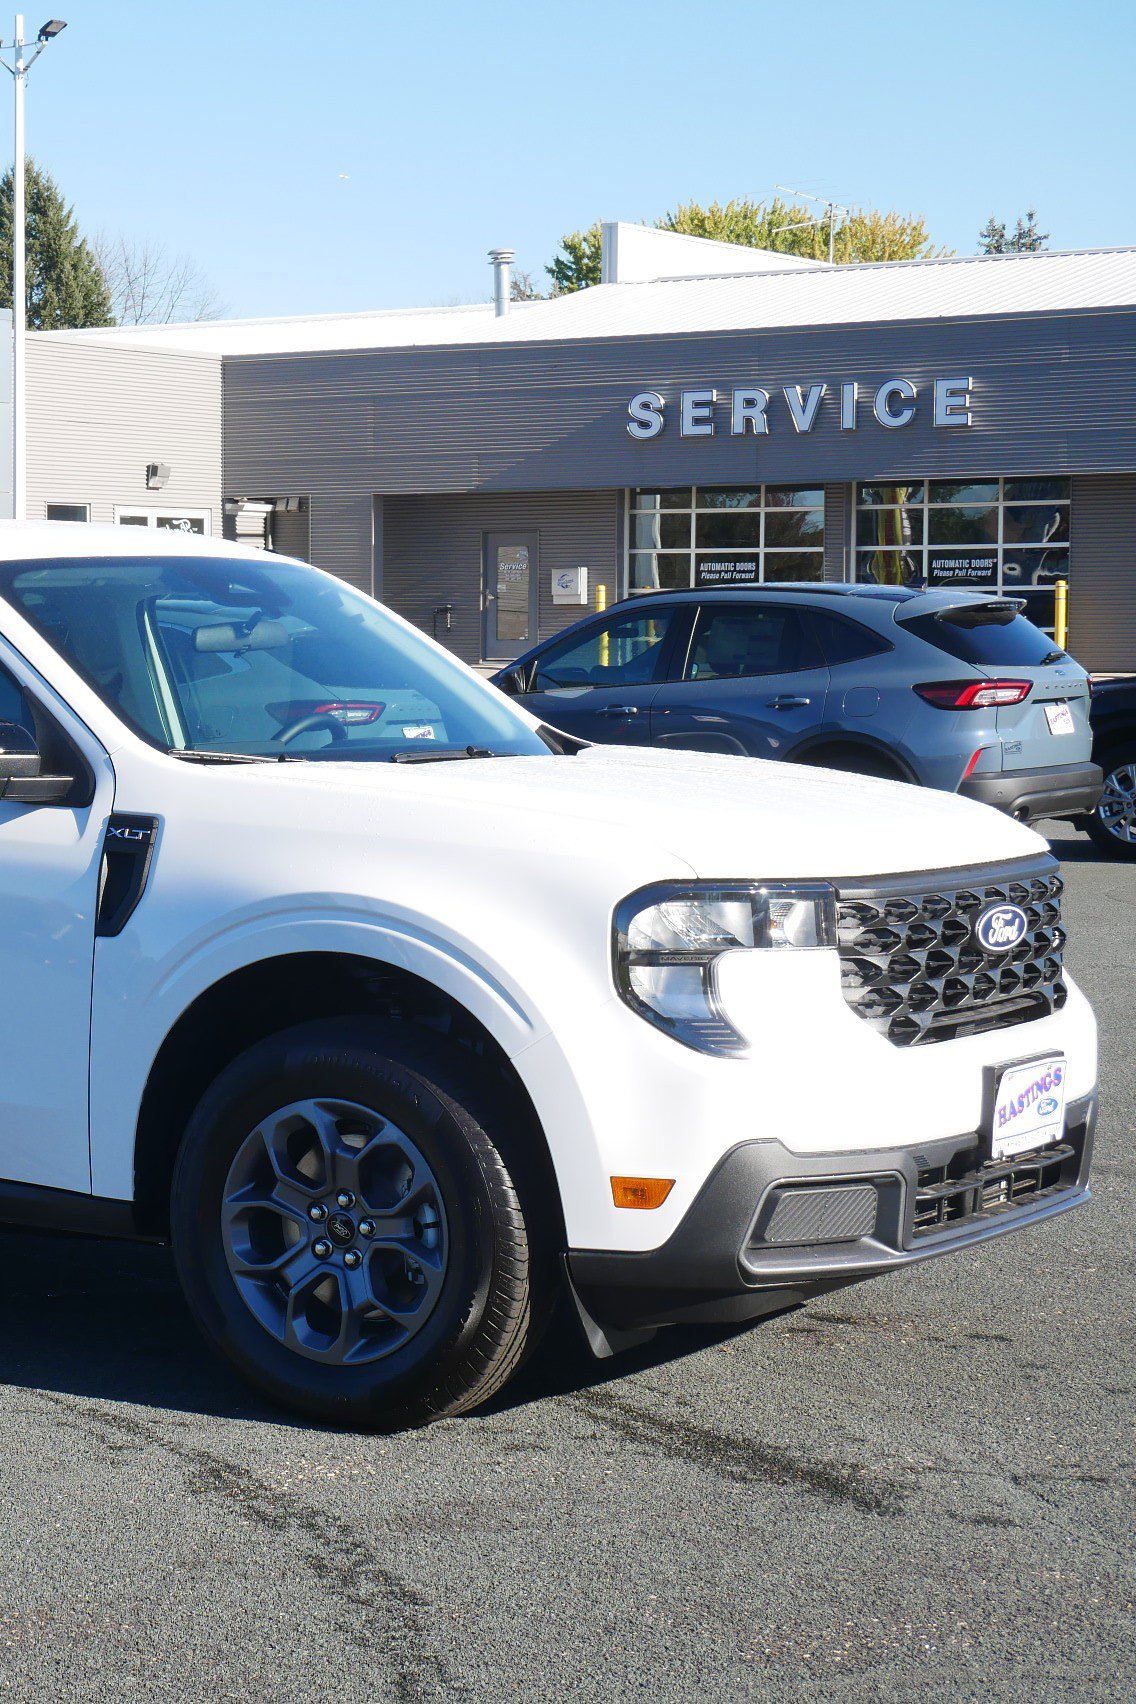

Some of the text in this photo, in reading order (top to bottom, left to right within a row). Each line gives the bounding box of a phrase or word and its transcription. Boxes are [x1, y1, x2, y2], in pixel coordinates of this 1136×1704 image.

[627, 377, 973, 439] SERVICE
[499, 562, 527, 570] Service
[700, 562, 756, 571] AUTOMATIC DOORS
[932, 559, 993, 568] AUTOMATIC DOORS
[732, 571, 755, 579] Forward
[933, 569, 992, 577] Please Pull Forward
[106, 827, 151, 840] XLT
[988, 912, 1020, 944] Ford
[998, 1066, 1062, 1128] HASTINGS
